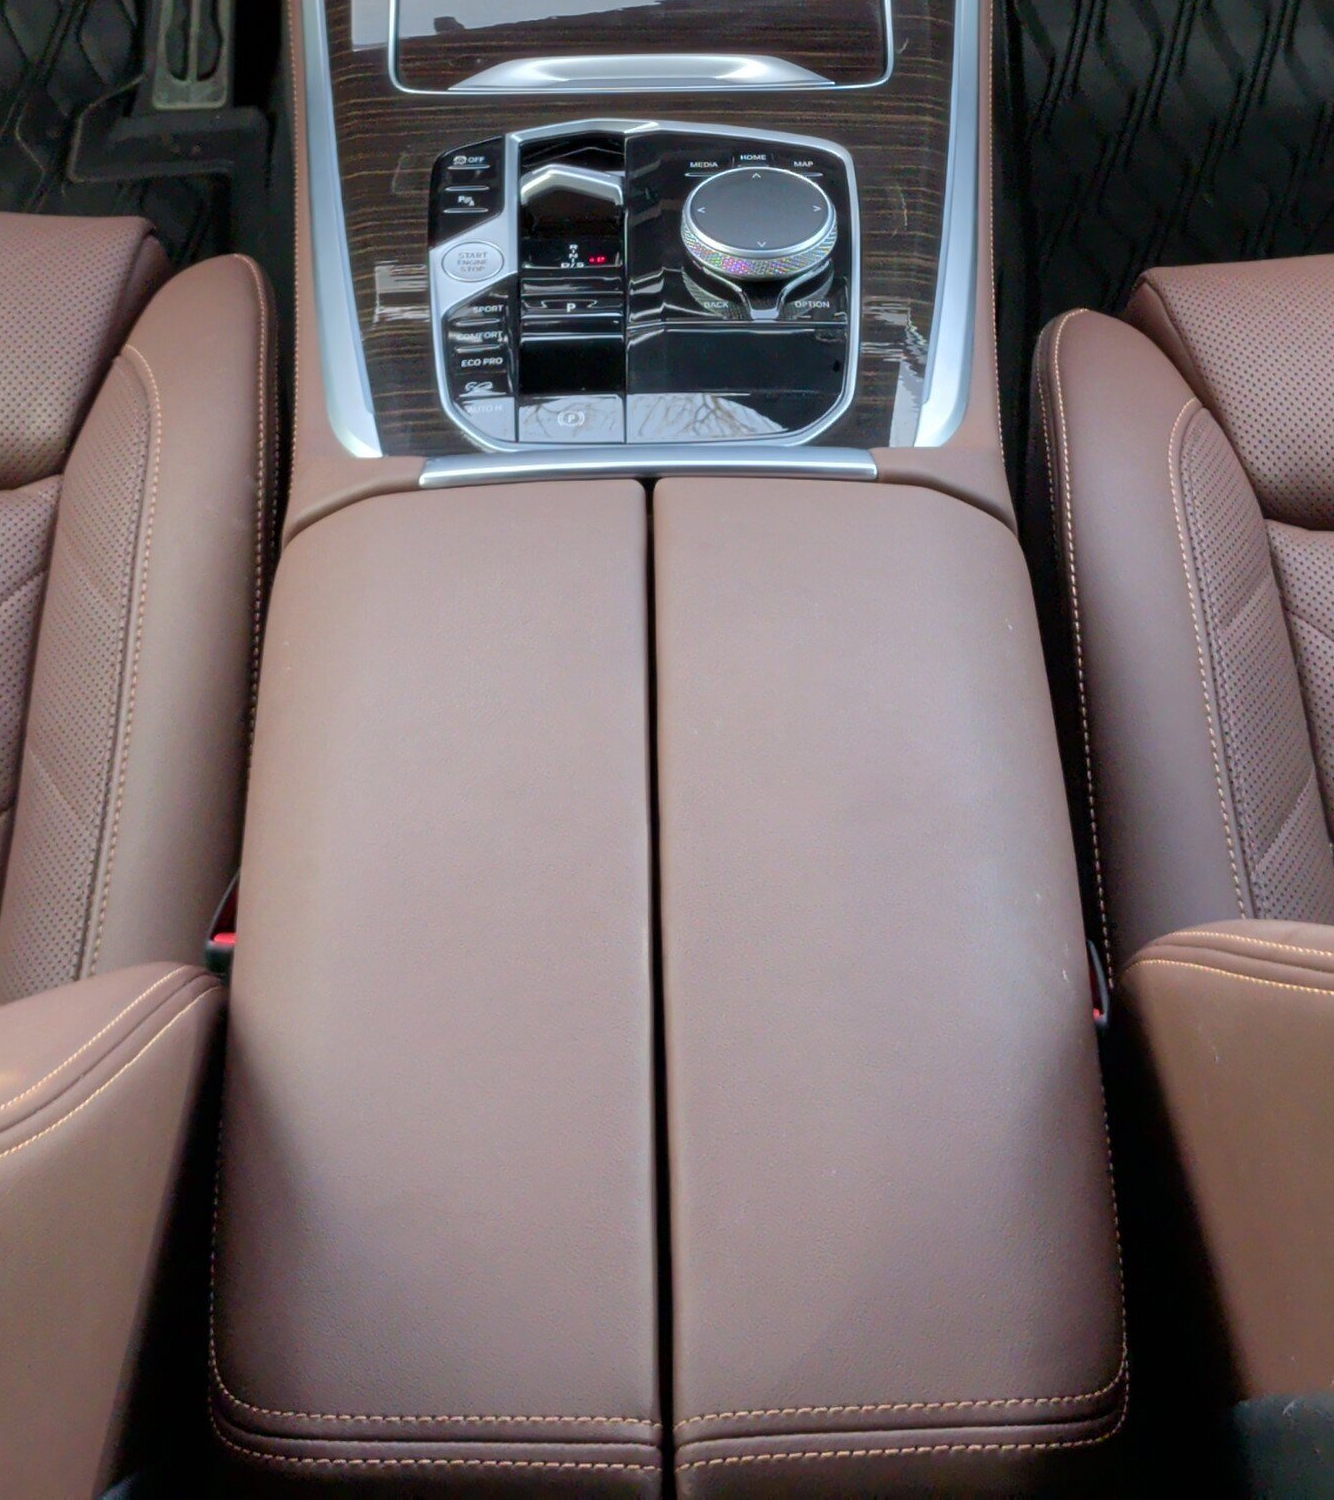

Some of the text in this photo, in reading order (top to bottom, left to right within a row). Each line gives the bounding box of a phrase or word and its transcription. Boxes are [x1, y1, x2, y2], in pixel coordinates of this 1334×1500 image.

[458, 251, 488, 259] START
[567, 303, 576, 313] P
[704, 300, 729, 308] BACK
[794, 300, 830, 308] OPTION
[473, 305, 504, 313] SPORT
[456, 331, 504, 341] COMFORT
[461, 357, 503, 367] ECO PRO
